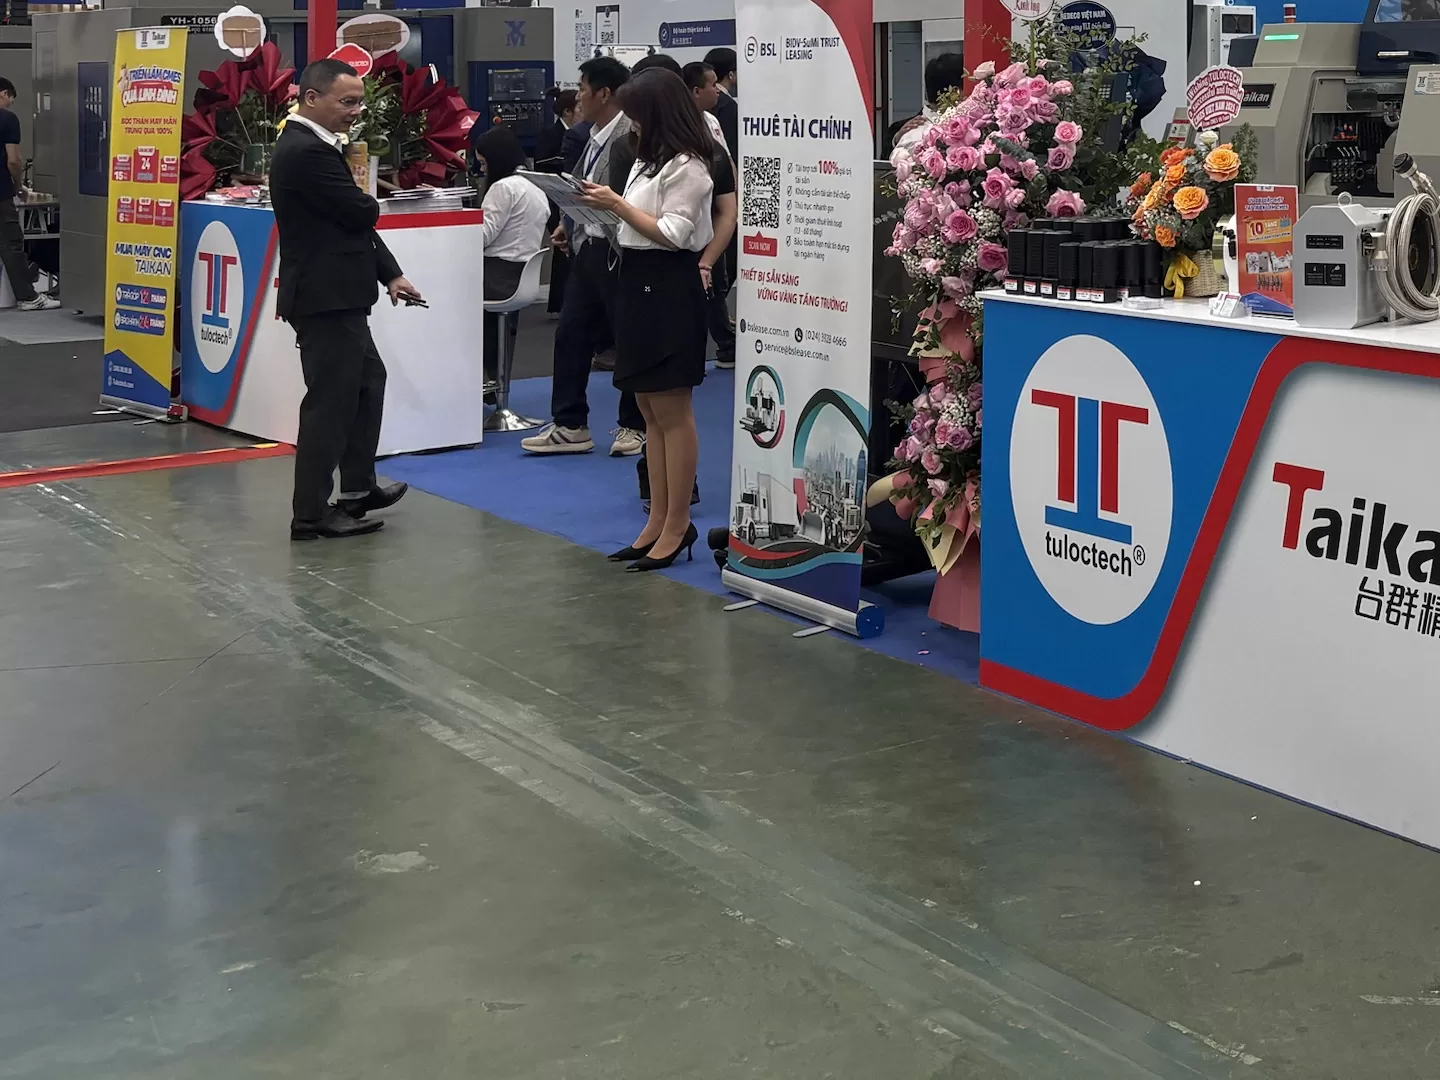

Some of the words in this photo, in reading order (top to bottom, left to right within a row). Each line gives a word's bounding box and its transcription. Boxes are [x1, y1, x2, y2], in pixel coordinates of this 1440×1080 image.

[820, 37, 840, 47] TRUST
[761, 43, 776, 56] BSL
[786, 50, 812, 60] LEASING
[163, 69, 182, 83] CMES
[1208, 70, 1240, 85] TULOCTECH
[1243, 92, 1269, 102] aikan
[743, 114, 780, 136] THUÊ
[783, 114, 804, 137] TÀI
[808, 116, 851, 140] CHÍNH
[141, 158, 150, 170] 24
[1250, 222, 1263, 236] 10
[115, 243, 132, 254] MUA
[134, 241, 151, 256] MÁY
[153, 246, 172, 258] CNC
[136, 259, 171, 276] TAIKAN
[740, 267, 757, 281] THIẾT
[758, 271, 765, 285] BỊ
[766, 268, 781, 284] SẴN
[781, 271, 799, 286] SÀNG
[758, 286, 778, 301] VỮNG
[779, 288, 797, 304] VÀNG
[799, 292, 819, 307] TĂNG
